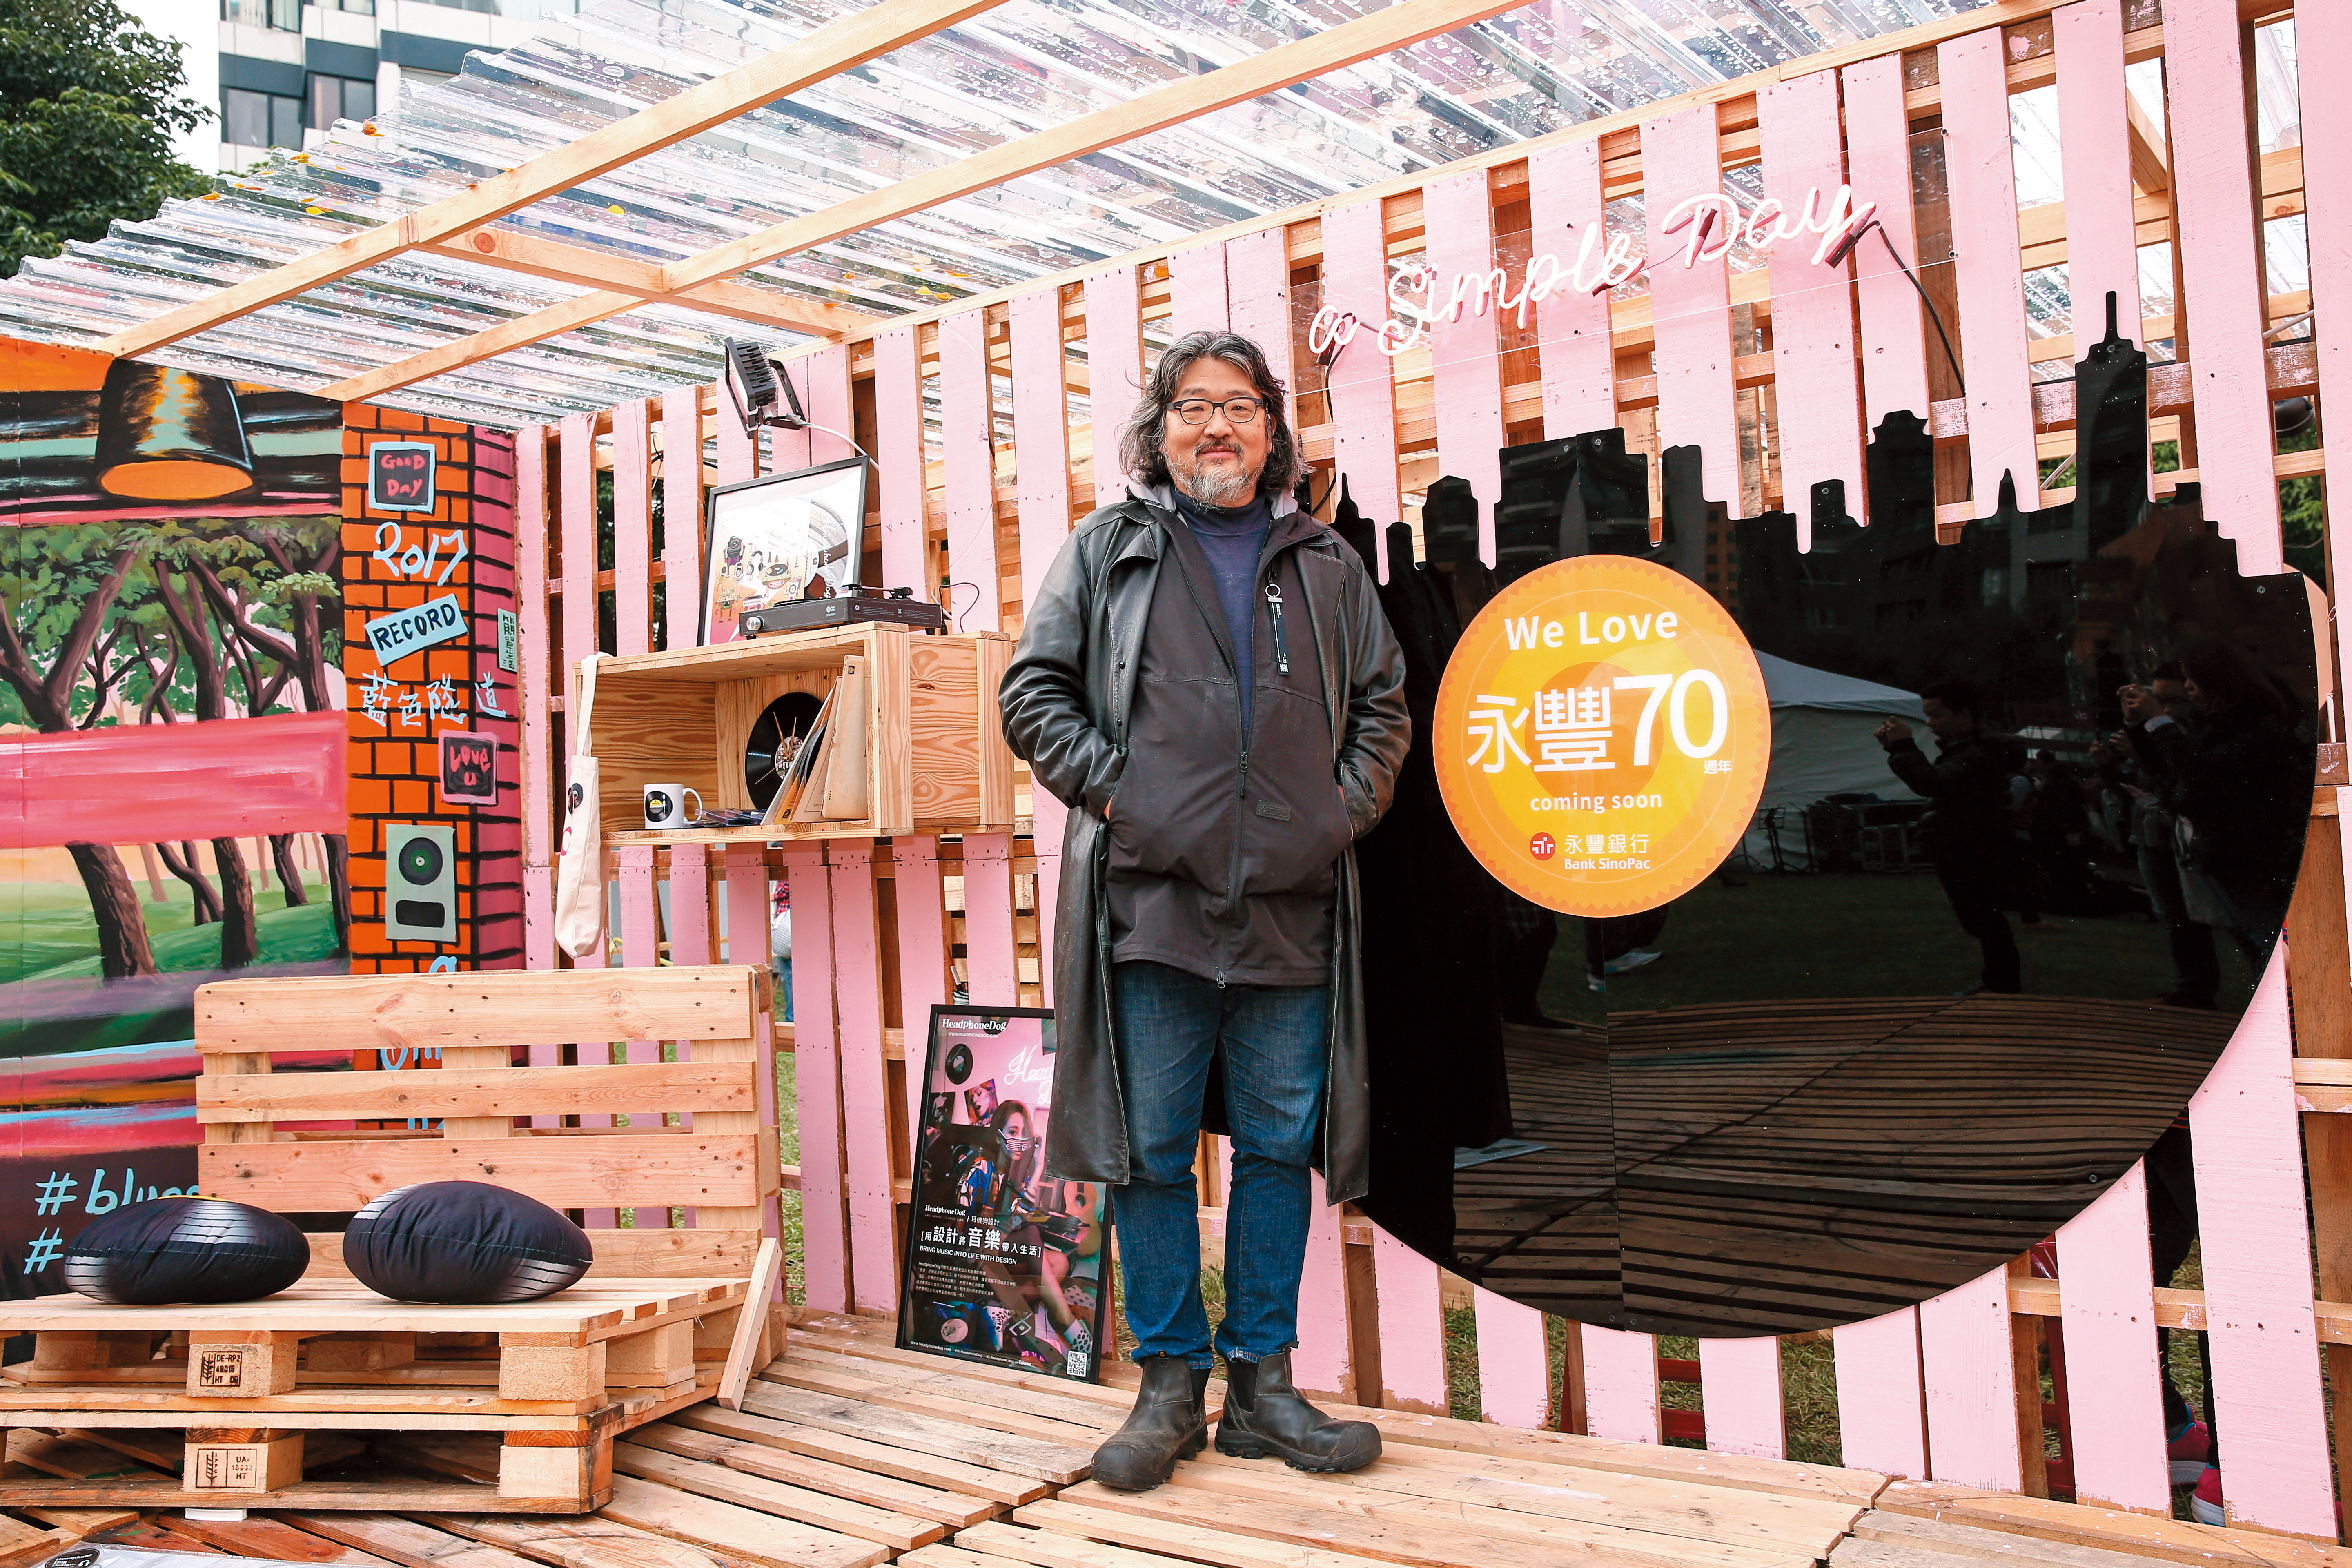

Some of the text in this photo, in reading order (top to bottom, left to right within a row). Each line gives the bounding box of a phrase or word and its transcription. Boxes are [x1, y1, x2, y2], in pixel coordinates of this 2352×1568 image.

[1377, 222, 1646, 356] Simple
[1662, 184, 1876, 270] Day
[373, 522, 468, 587] 2017
[373, 604, 457, 652] RECORD
[1505, 611, 1678, 651] We Love
[1530, 793, 1662, 814] coming soon
[1564, 834, 1650, 855] 永豐銀行
[1564, 858, 1650, 870] Bank SinoPac
[942, 1018, 1007, 1031] HeadphoneDog
[925, 1205, 966, 1216] HeadphoneDog
[995, 1256, 1017, 1265] DESIGN
